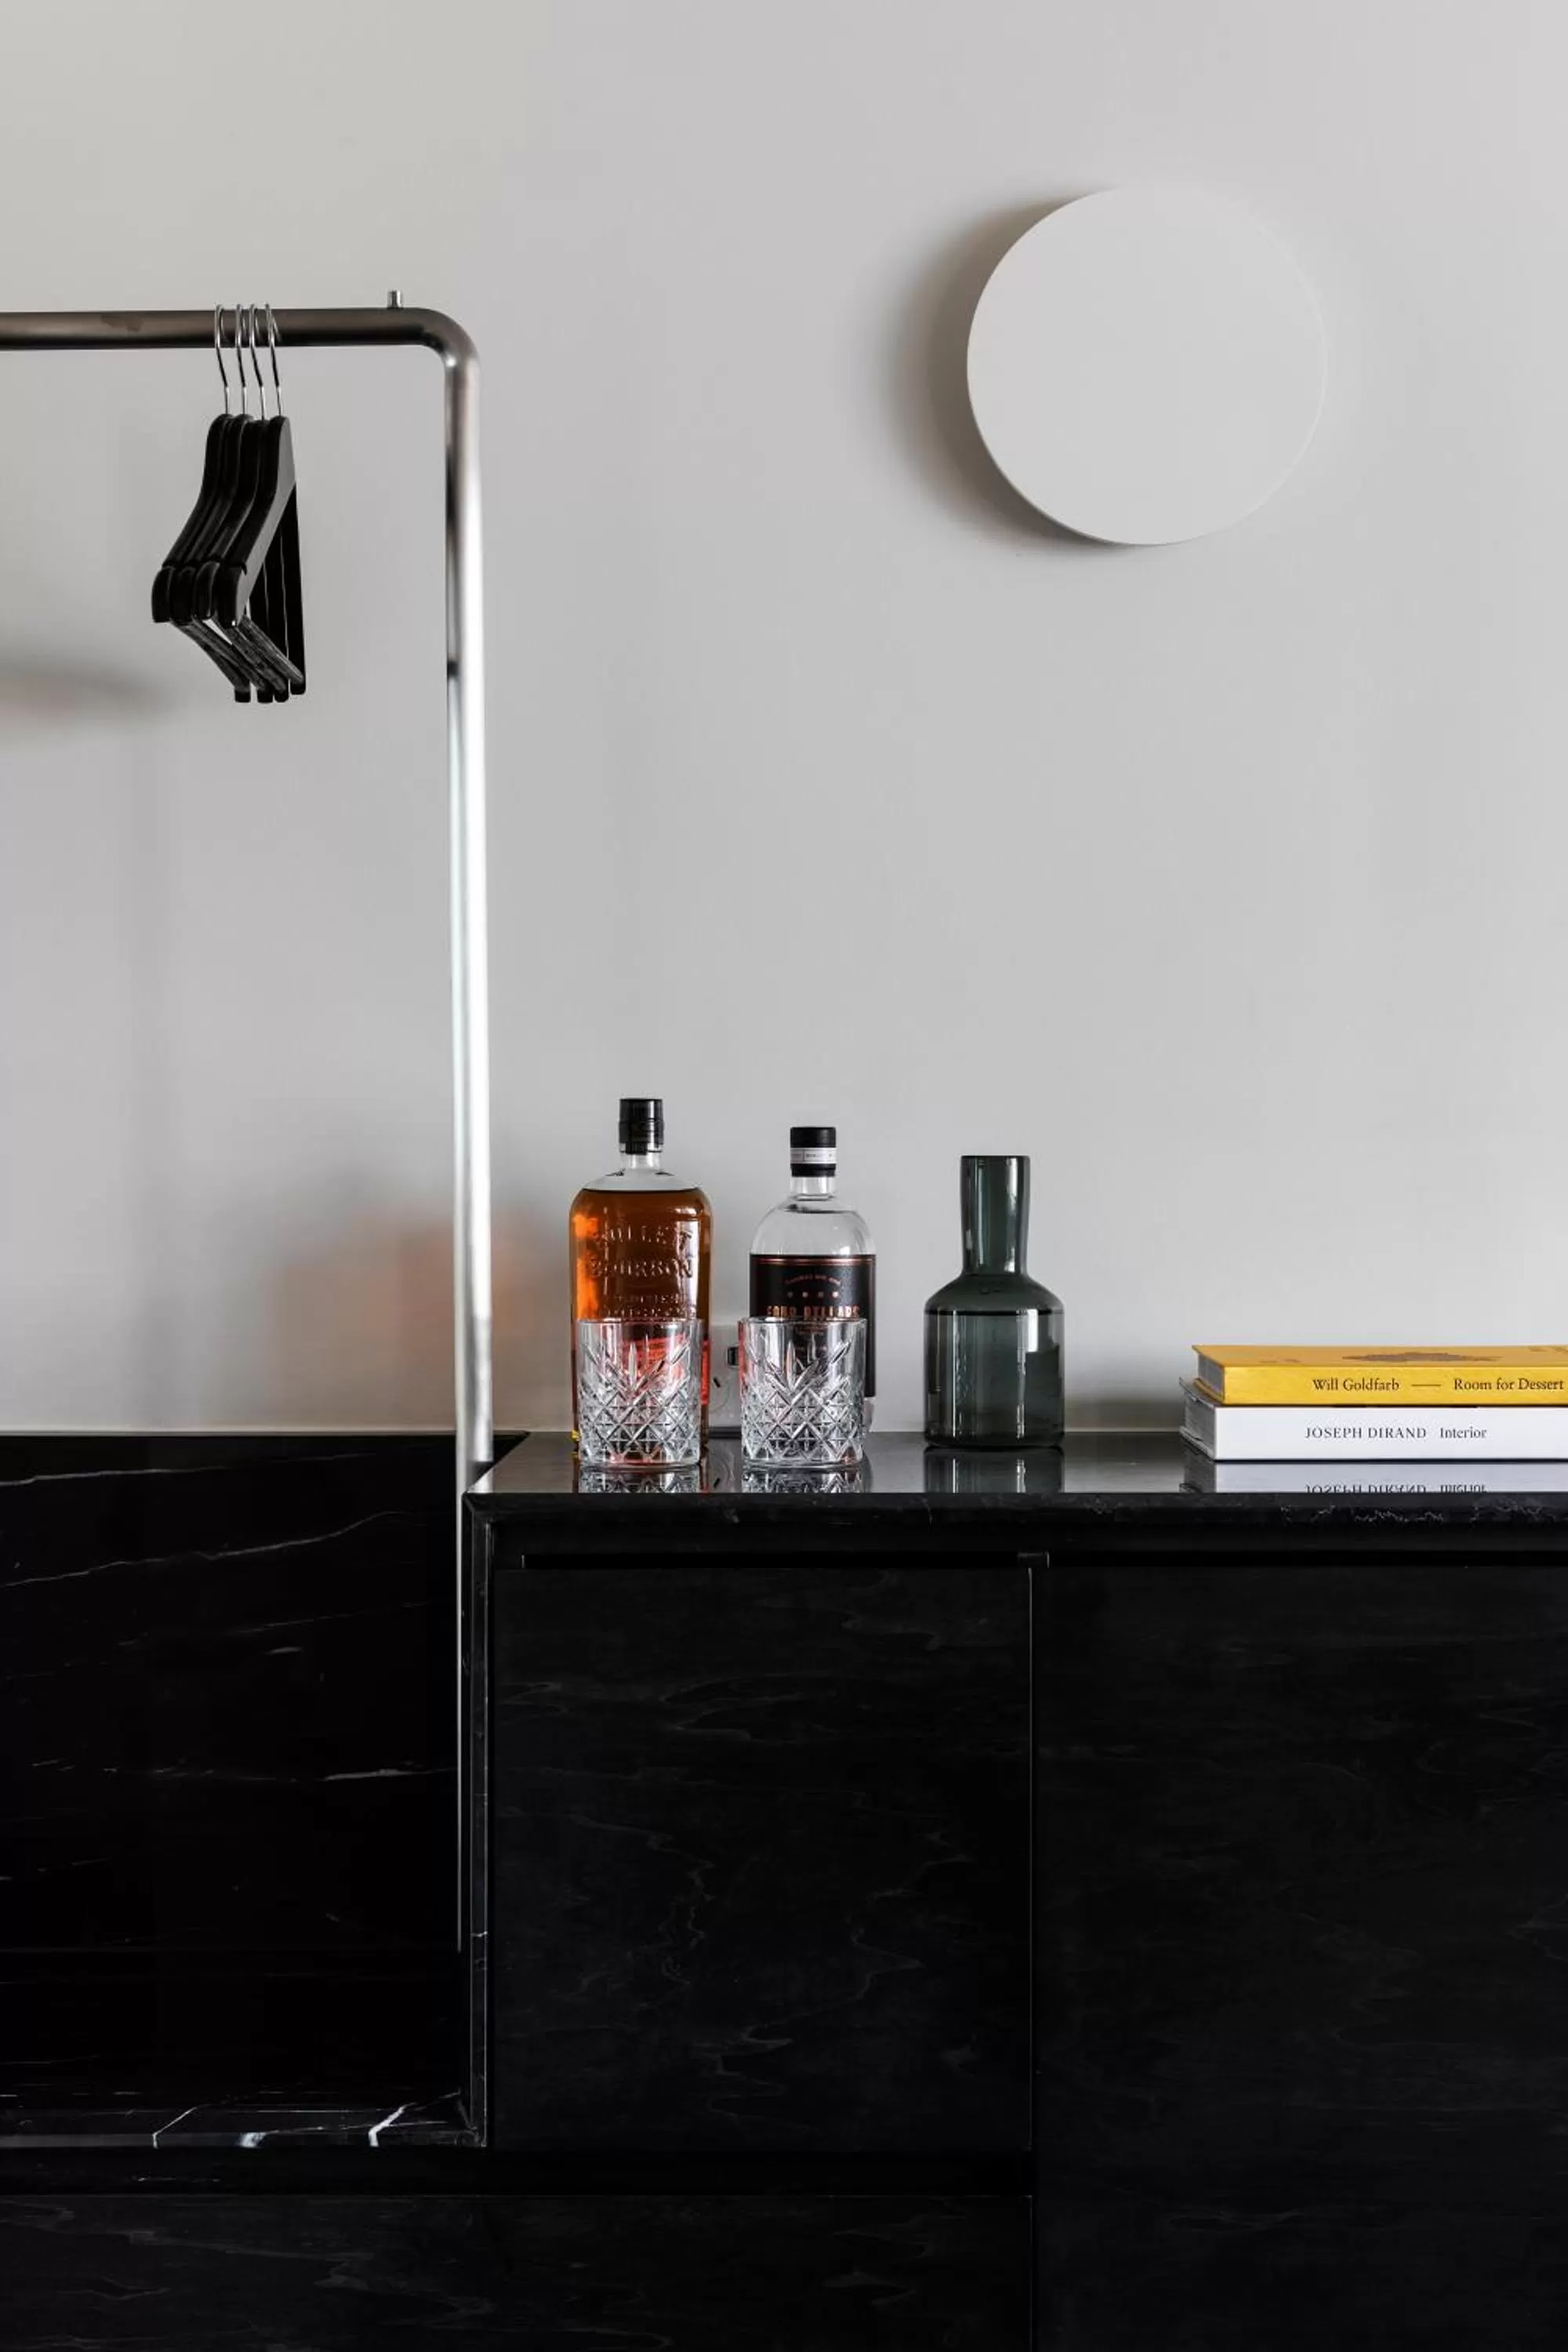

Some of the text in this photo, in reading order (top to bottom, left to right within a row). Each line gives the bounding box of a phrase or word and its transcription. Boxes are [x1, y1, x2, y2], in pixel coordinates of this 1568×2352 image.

[1312, 1377, 1564, 1392] Will Goldfarb Room for Dessert
[1305, 1425, 1487, 1439] JOSEPH DIRAND Interior
